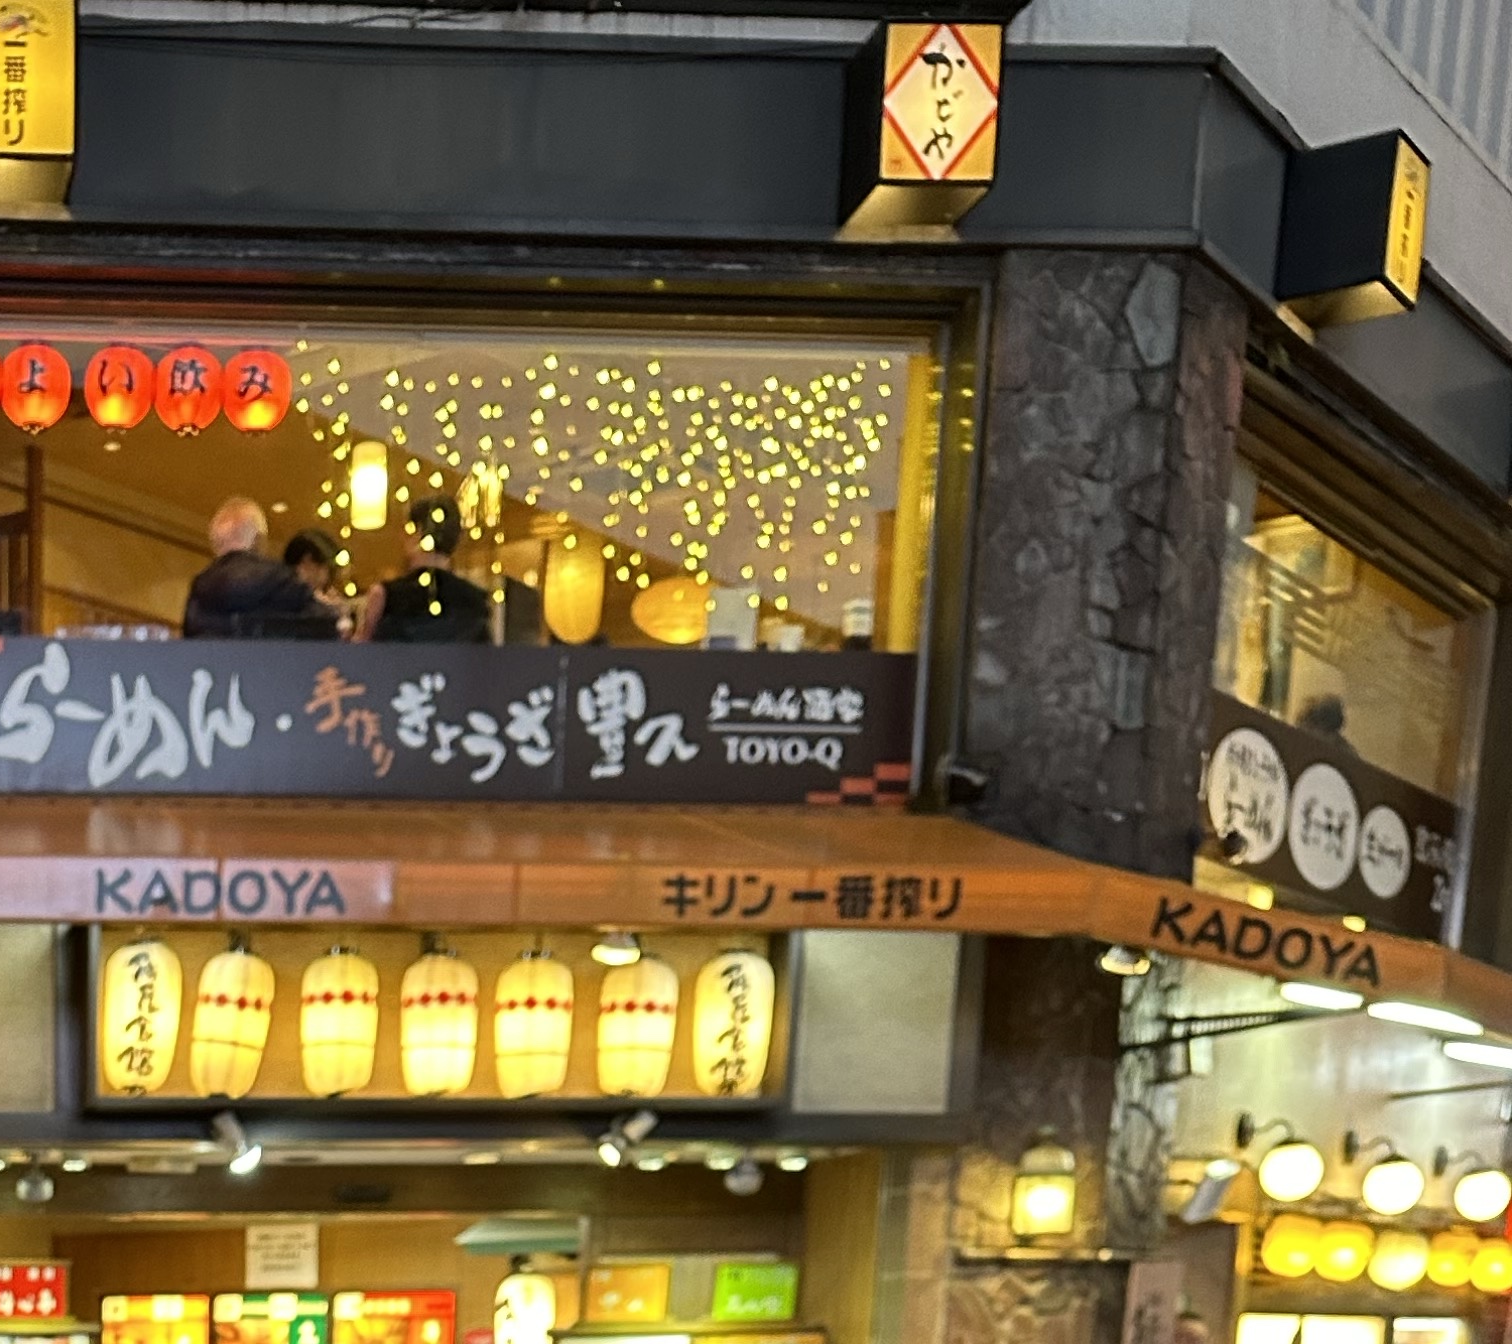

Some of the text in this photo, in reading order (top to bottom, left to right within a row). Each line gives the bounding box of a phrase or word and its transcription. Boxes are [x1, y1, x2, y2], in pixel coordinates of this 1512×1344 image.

[1, 40, 28, 147] 一番搾り
[95, 867, 347, 915] KADOYA
[1150, 895, 1381, 988] KADOYA
